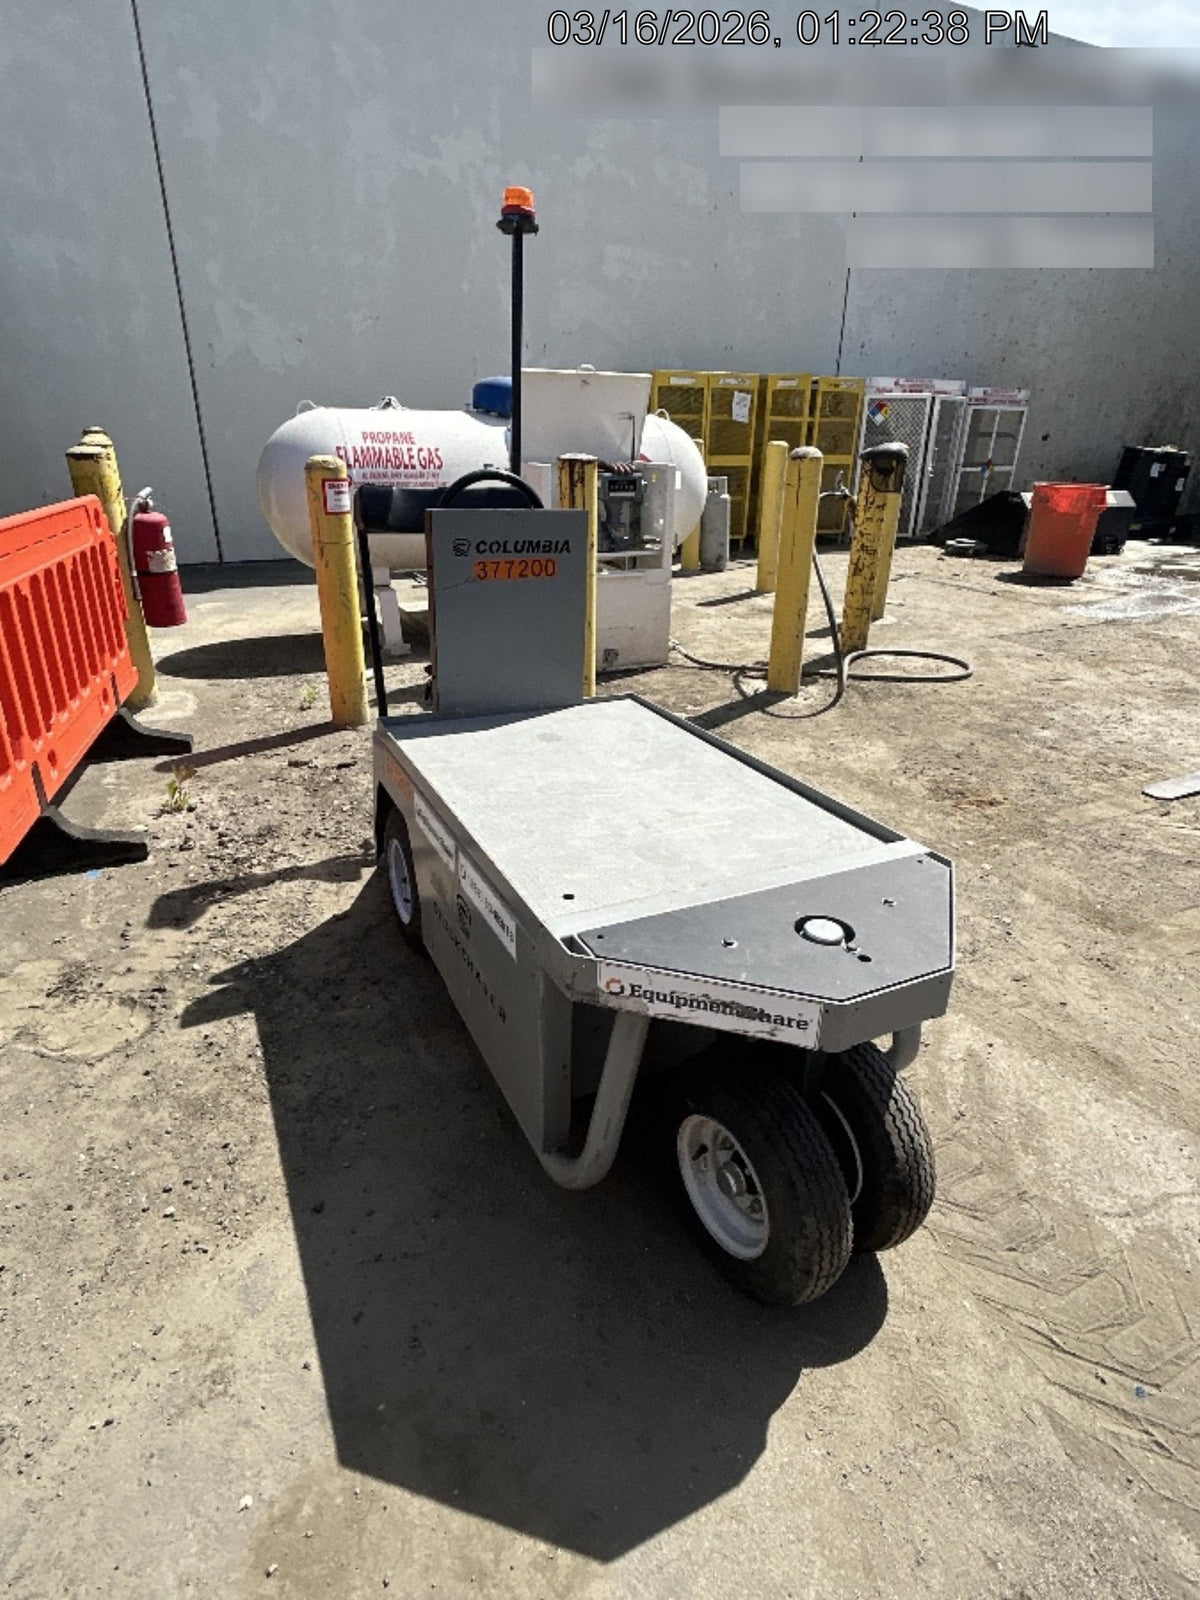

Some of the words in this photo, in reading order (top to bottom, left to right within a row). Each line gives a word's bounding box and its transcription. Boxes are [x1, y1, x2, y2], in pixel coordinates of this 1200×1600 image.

[361, 431, 416, 445] PROPANE
[335, 446, 417, 470] FLAMMABLE
[417, 447, 444, 470] GAS
[475, 540, 571, 554] COLUMBIA
[477, 559, 556, 580] 377200
